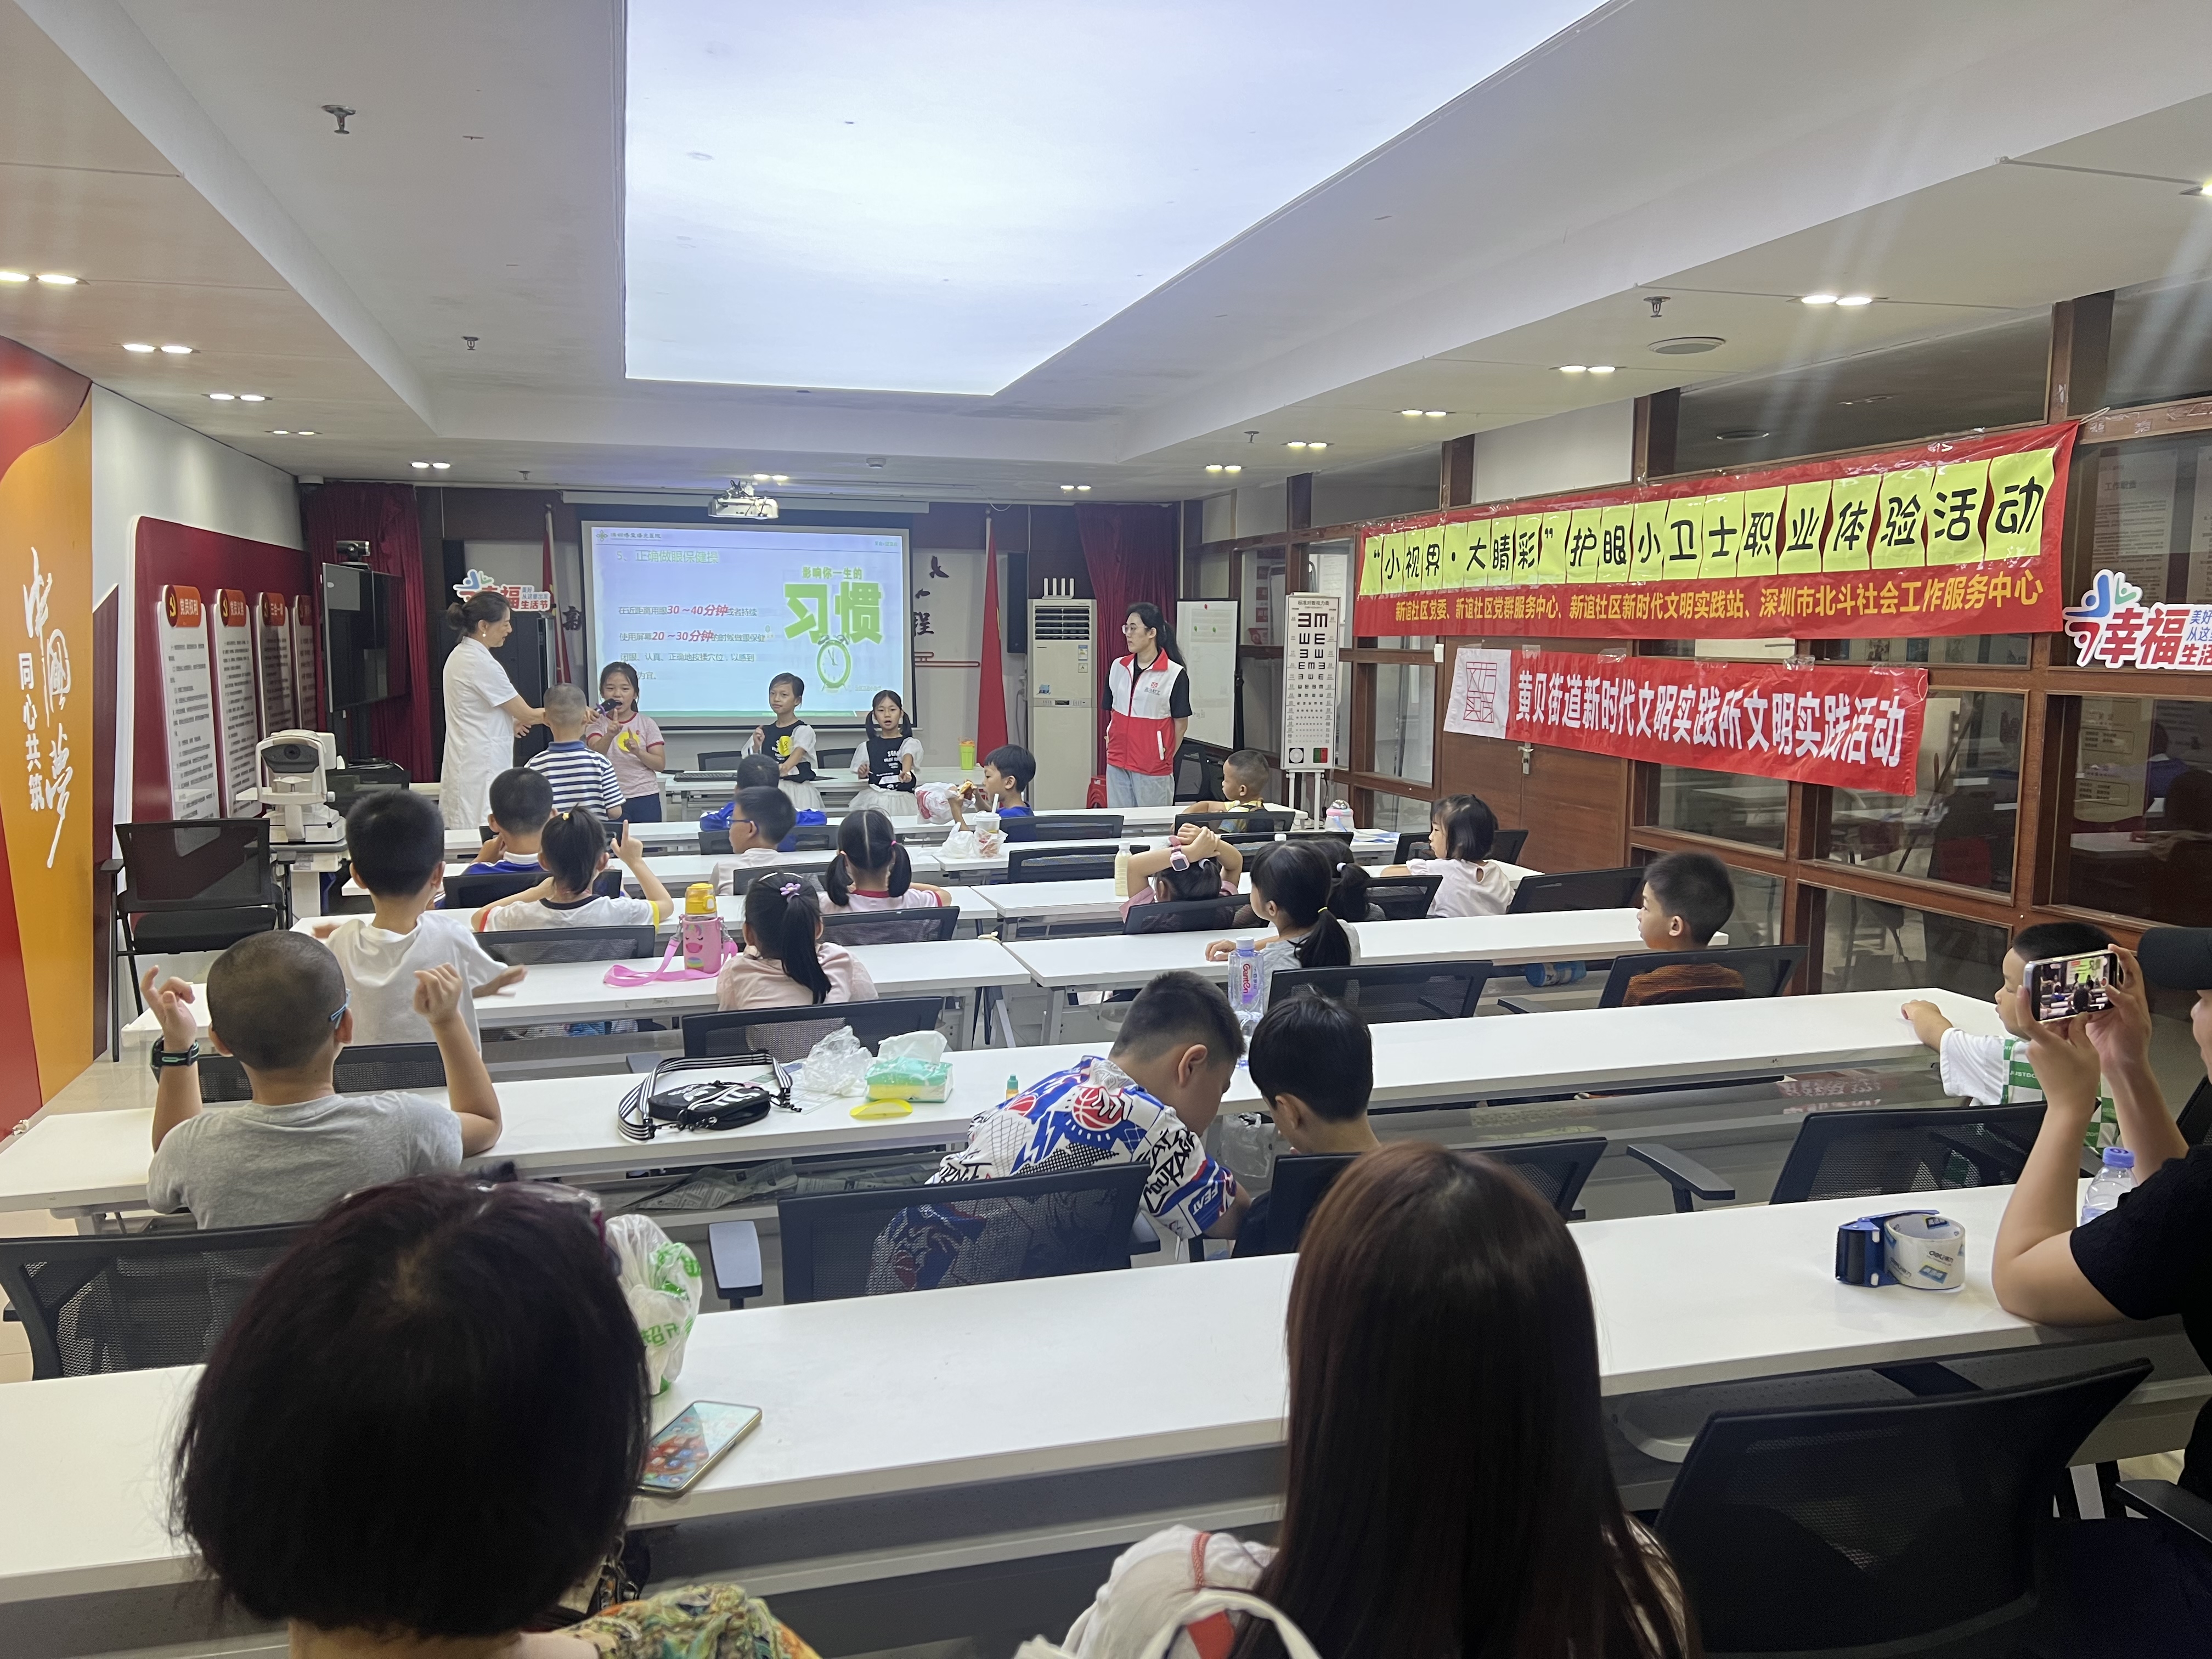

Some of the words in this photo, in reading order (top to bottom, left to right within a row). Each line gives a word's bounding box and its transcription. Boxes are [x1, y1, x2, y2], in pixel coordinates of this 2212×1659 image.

[802, 566, 862, 580] 影响你一生的
[521, 600, 548, 610] 生活节
[784, 581, 882, 645] 习惯
[2190, 609, 2212, 625] 美好
[2099, 607, 2191, 664] 幸福
[2179, 644, 2212, 665] 生活
[19, 653, 45, 811] 同心共筑
[1515, 669, 1905, 768] 黄贝街道新时代文明实践所文明实践活动
